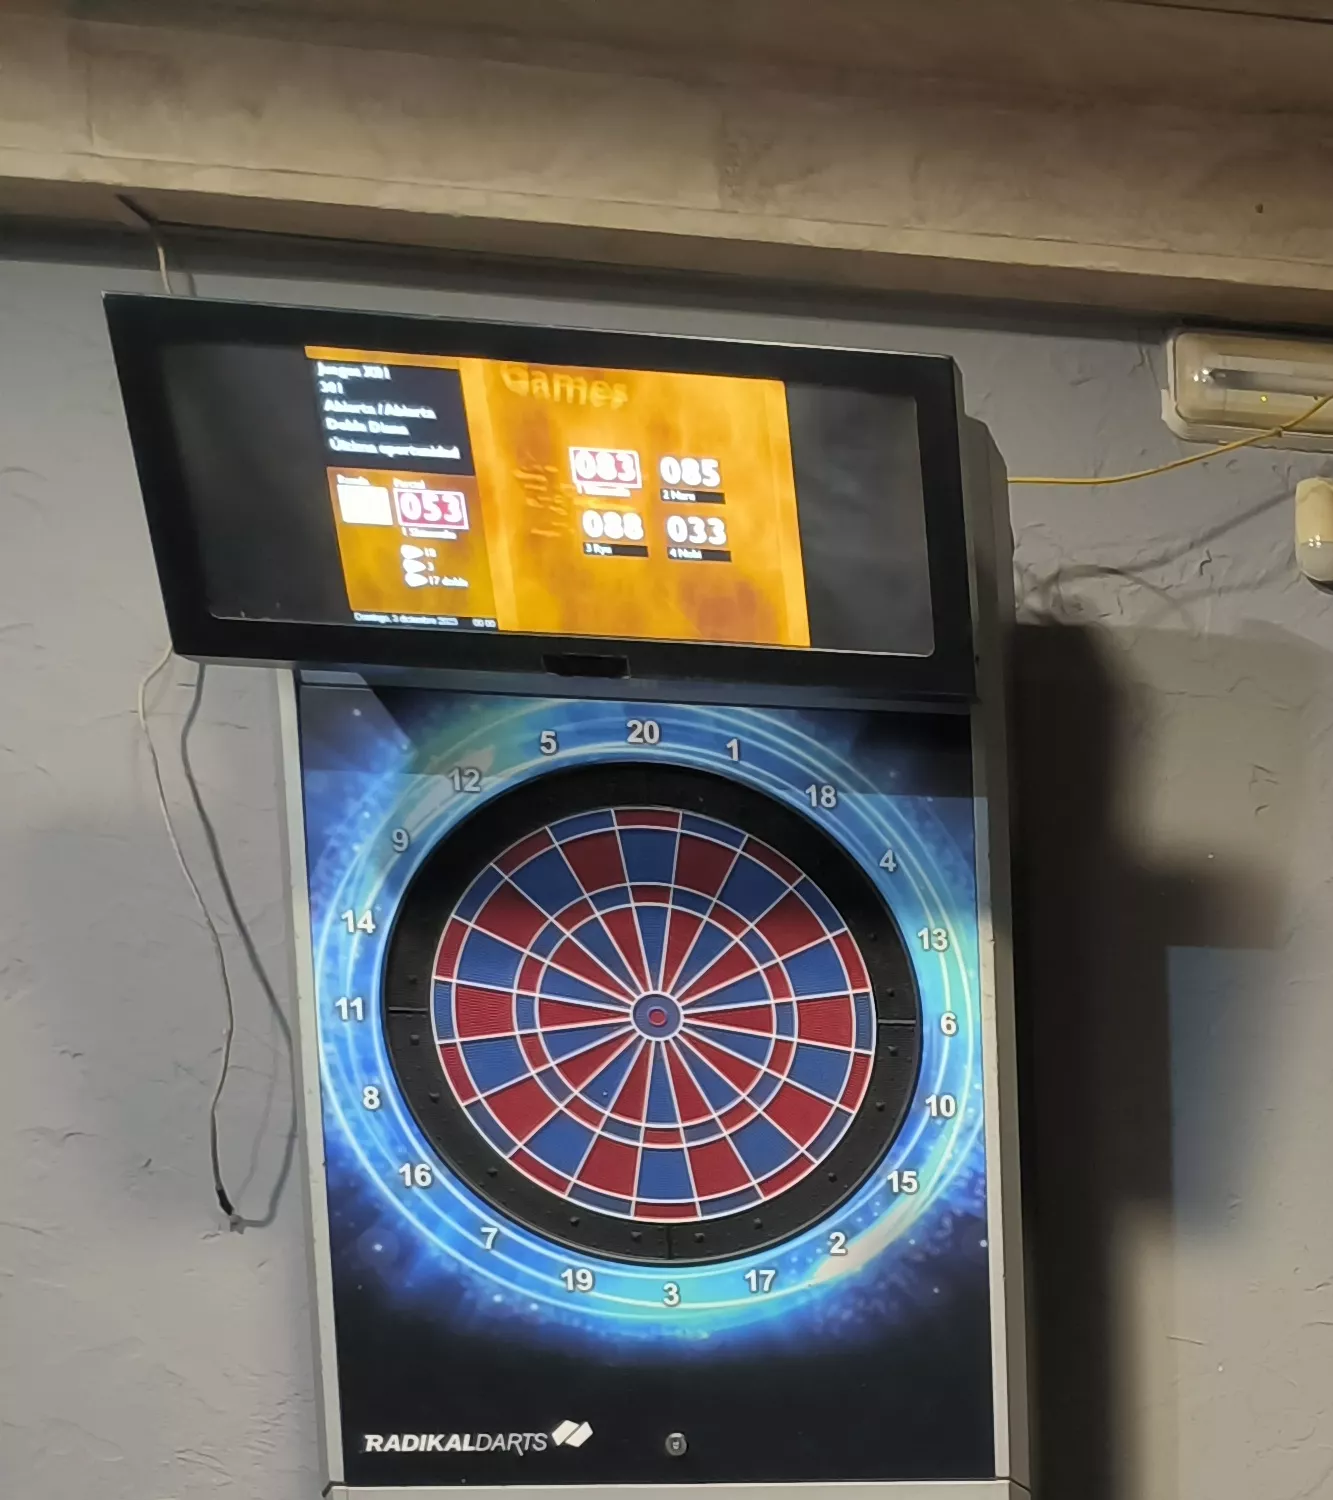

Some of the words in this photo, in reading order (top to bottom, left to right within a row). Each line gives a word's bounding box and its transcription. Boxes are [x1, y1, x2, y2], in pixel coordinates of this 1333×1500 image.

[575, 450, 636, 481] 083
[660, 456, 721, 487] 085
[399, 491, 464, 523] 053
[582, 510, 644, 540] 088
[667, 515, 727, 545] 033
[540, 731, 557, 754] 5
[625, 720, 660, 745] 20
[726, 739, 740, 761] 1
[448, 768, 481, 793] 12
[804, 785, 837, 809] 18
[391, 830, 411, 852] 9
[878, 849, 897, 872] 4
[340, 910, 376, 935] 14
[917, 928, 948, 951] 13
[336, 997, 364, 1021] 11
[939, 1013, 958, 1036] 6
[362, 1086, 381, 1109] 8
[925, 1095, 956, 1118] 10
[399, 1163, 432, 1188] 16
[887, 1170, 918, 1194] 15
[480, 1227, 498, 1250] 7
[828, 1232, 848, 1255] 2
[561, 1268, 595, 1293] 19
[744, 1269, 776, 1293] 17
[662, 1283, 680, 1306] 3
[364, 1432, 548, 1456] RADIKALDARTS
